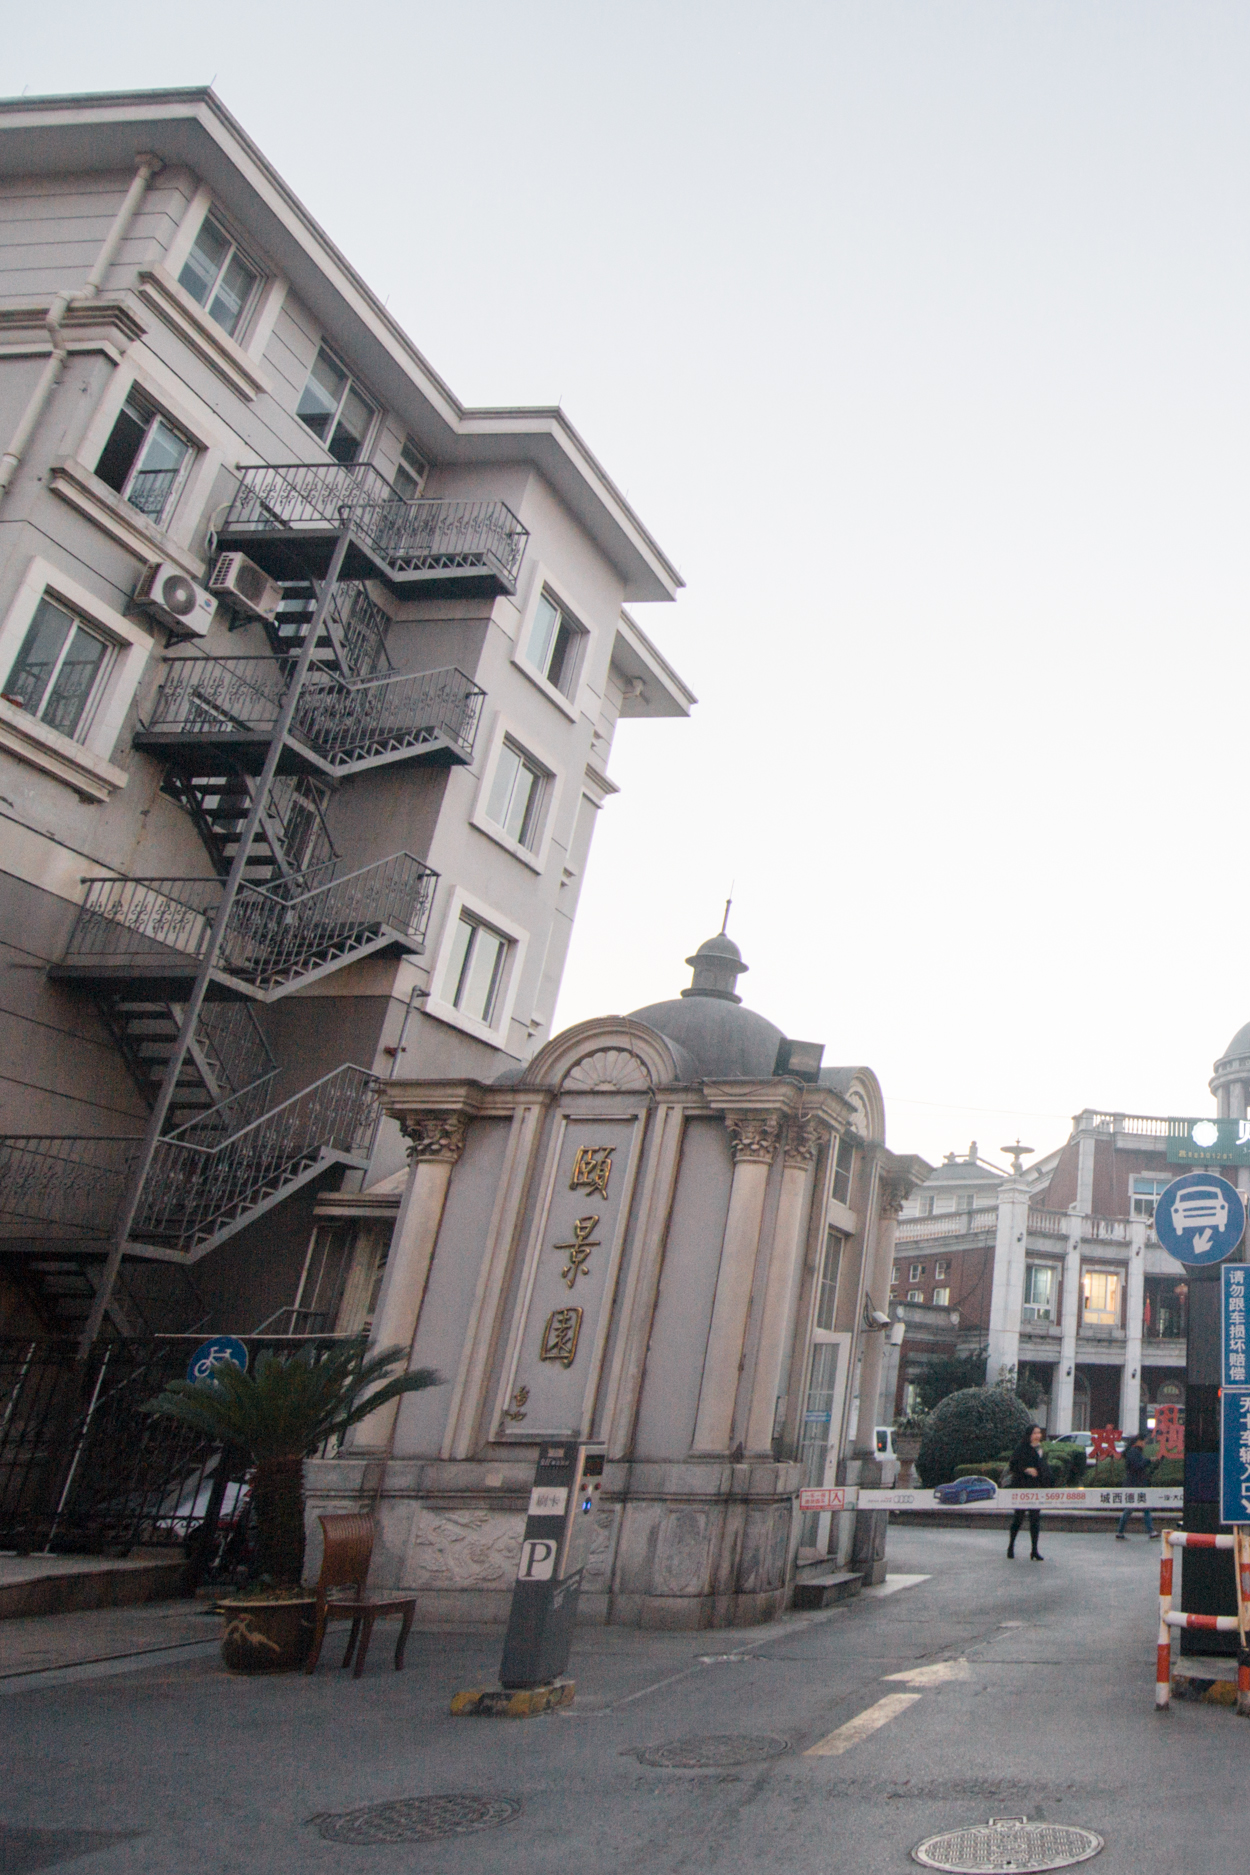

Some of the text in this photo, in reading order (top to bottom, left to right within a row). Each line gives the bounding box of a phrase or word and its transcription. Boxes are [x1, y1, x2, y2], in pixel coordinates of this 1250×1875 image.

[1228, 1270, 1246, 1381] 请勿跟车损坏赔偿
[831, 1491, 842, 1503] 入
[1100, 1492, 1147, 1504] 城西德奥
[523, 1541, 552, 1577] P
